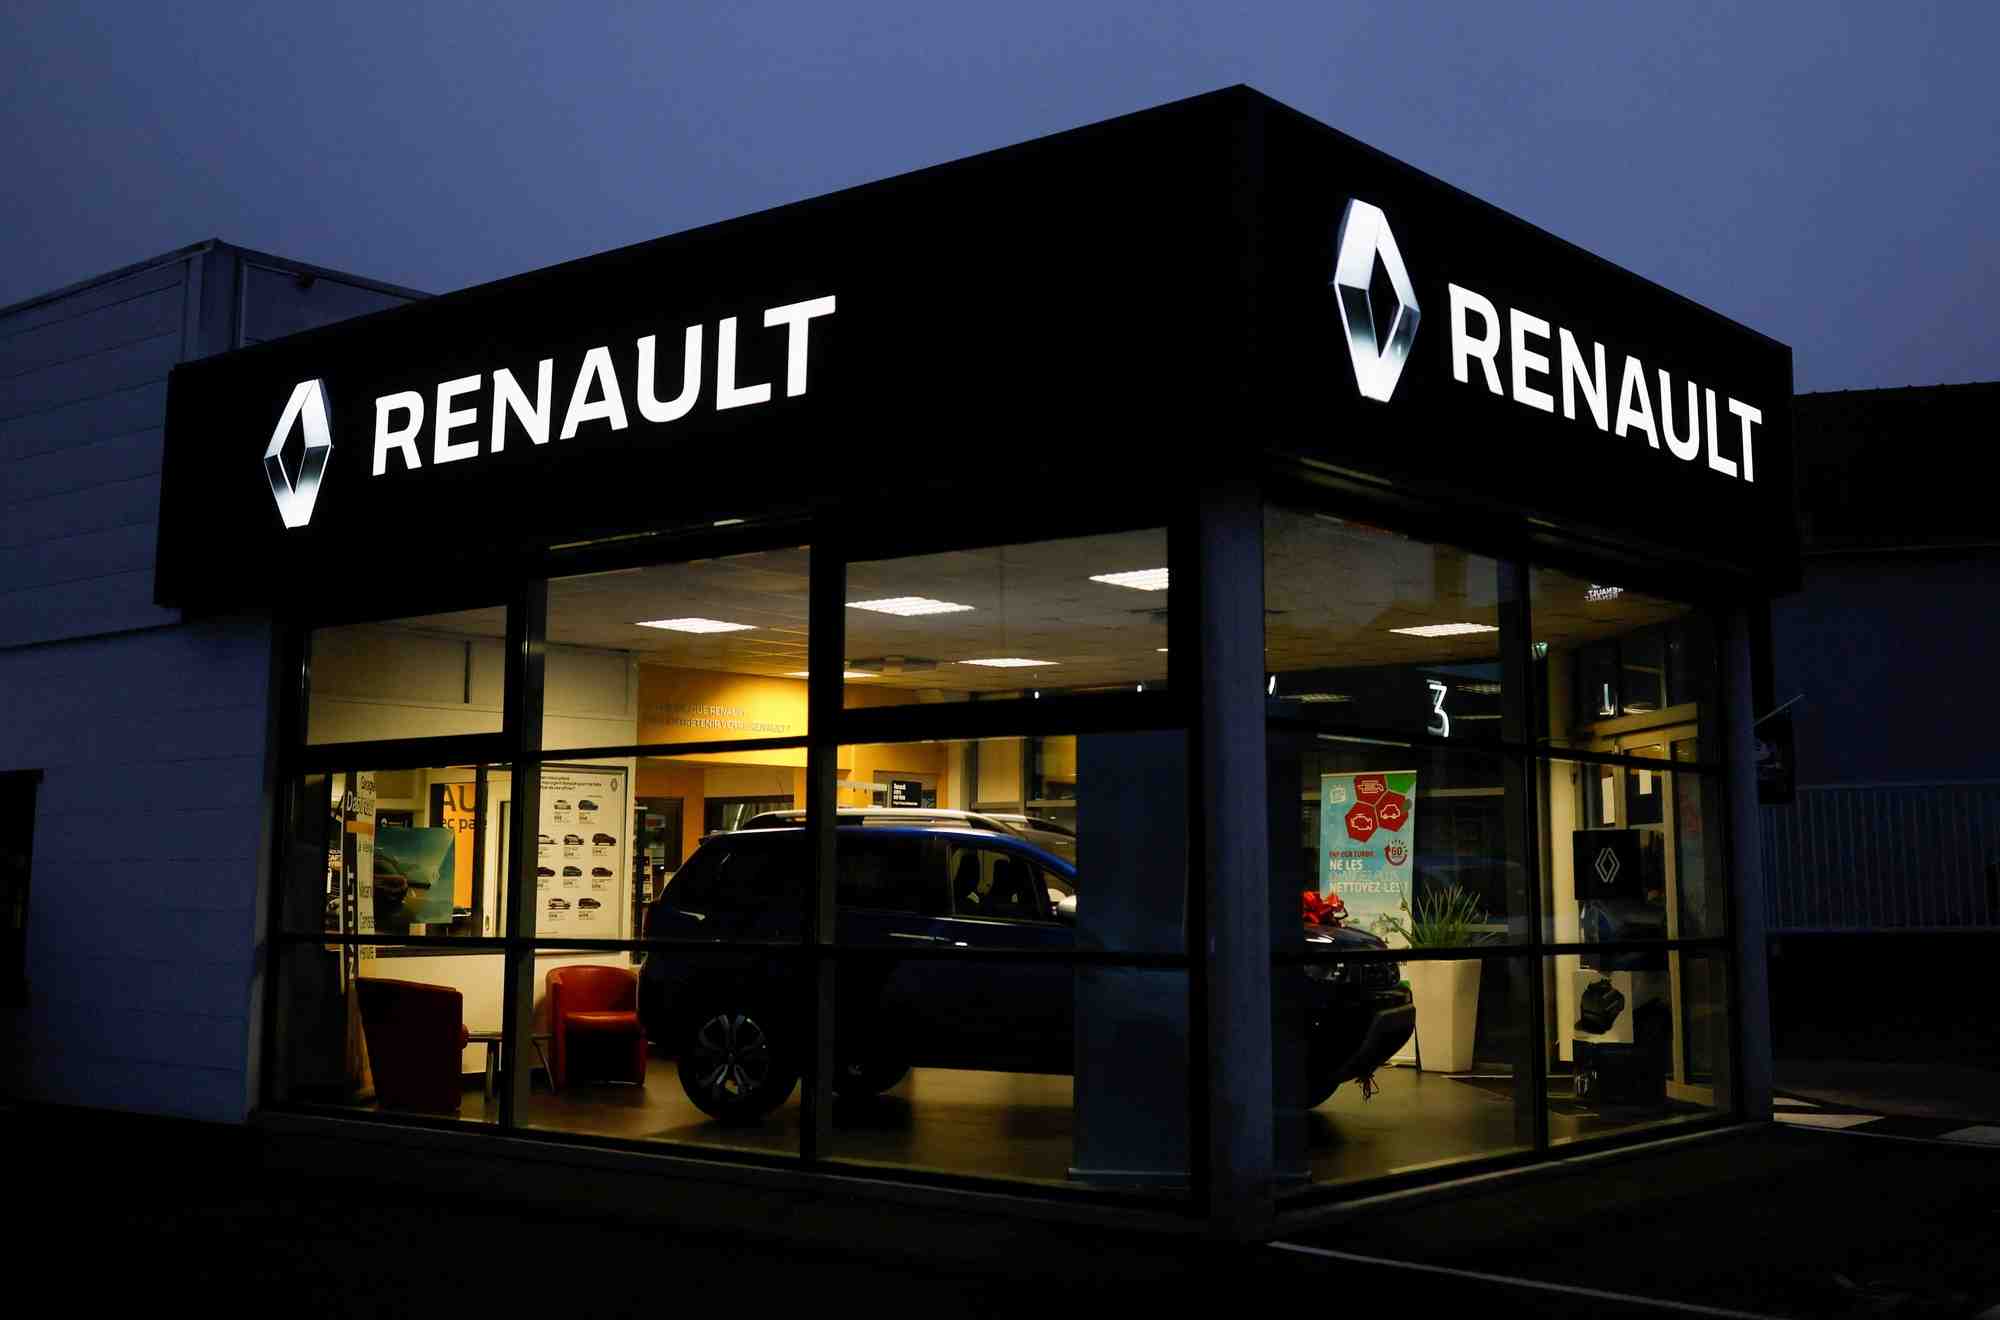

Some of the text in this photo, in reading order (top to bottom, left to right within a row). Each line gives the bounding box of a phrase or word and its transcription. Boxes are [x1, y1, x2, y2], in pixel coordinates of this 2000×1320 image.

[372, 295, 836, 476] RENAULT
[1449, 283, 1762, 483] RENAULT
[1329, 859, 1363, 871] NE LES
